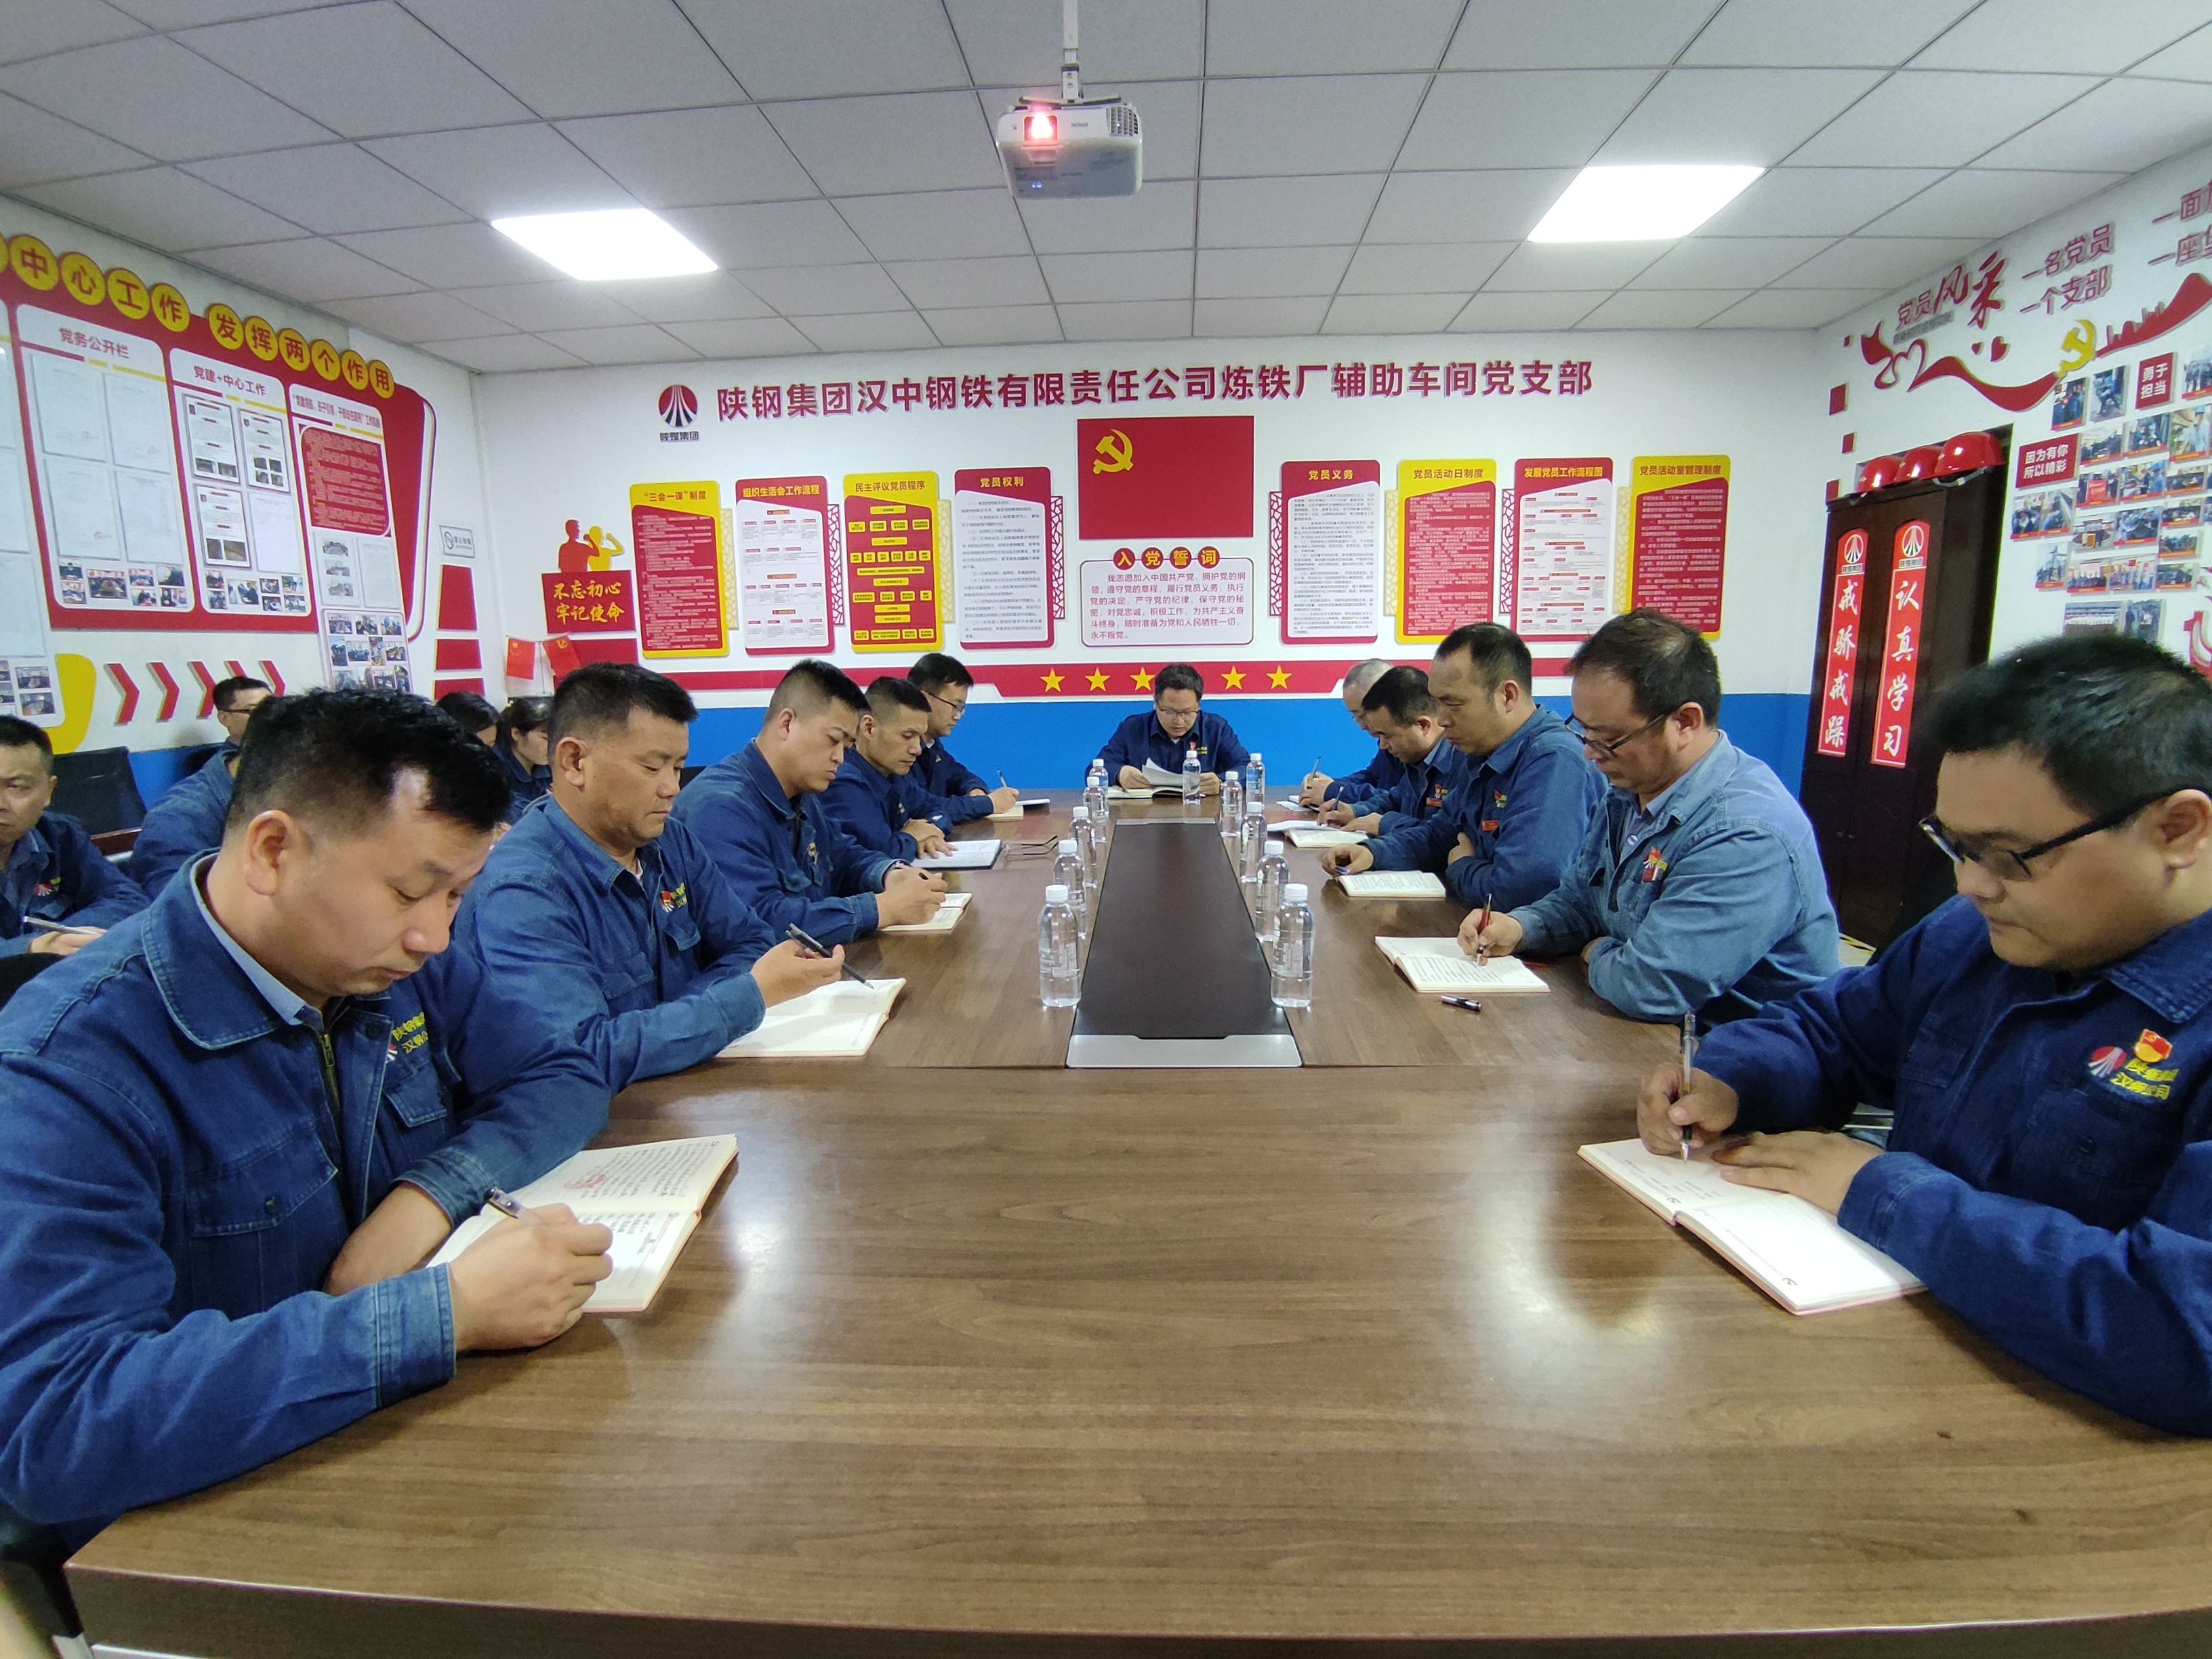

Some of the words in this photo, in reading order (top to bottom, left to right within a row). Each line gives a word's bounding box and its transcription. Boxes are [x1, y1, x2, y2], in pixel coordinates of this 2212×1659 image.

[2022, 223, 2112, 279] 一名党员
[2152, 178, 2212, 223] 一面
[2019, 265, 2109, 314] 一个支部
[59, 327, 129, 359] 党务公开栏
[193, 365, 266, 396] 党建+中心工作
[716, 359, 1593, 422] 陕钢集团汉中钢铁有限责任公司炼铁厂辅助车间党支部
[2139, 380, 2167, 400] 担当
[2024, 443, 2069, 465] 因为有你
[1308, 469, 1354, 480] 党员义务
[1413, 468, 1484, 479] 党员活动日制度
[1524, 467, 1603, 478] 发展党员工作流程图
[1639, 464, 1721, 476] 党员活动室管理制度
[2023, 459, 2068, 479] 所以精彩
[742, 485, 820, 497] 组织生活会工作流程
[855, 480, 926, 493] 民主评议党员程序
[980, 476, 1024, 488] 党员权利
[644, 490, 707, 502] “三会一课”制度
[1117, 550, 1217, 567] 入党誓词
[553, 579, 621, 600] 不忘初心
[556, 601, 625, 626] 牢记使命
[1883, 580, 1920, 757] 认真学习
